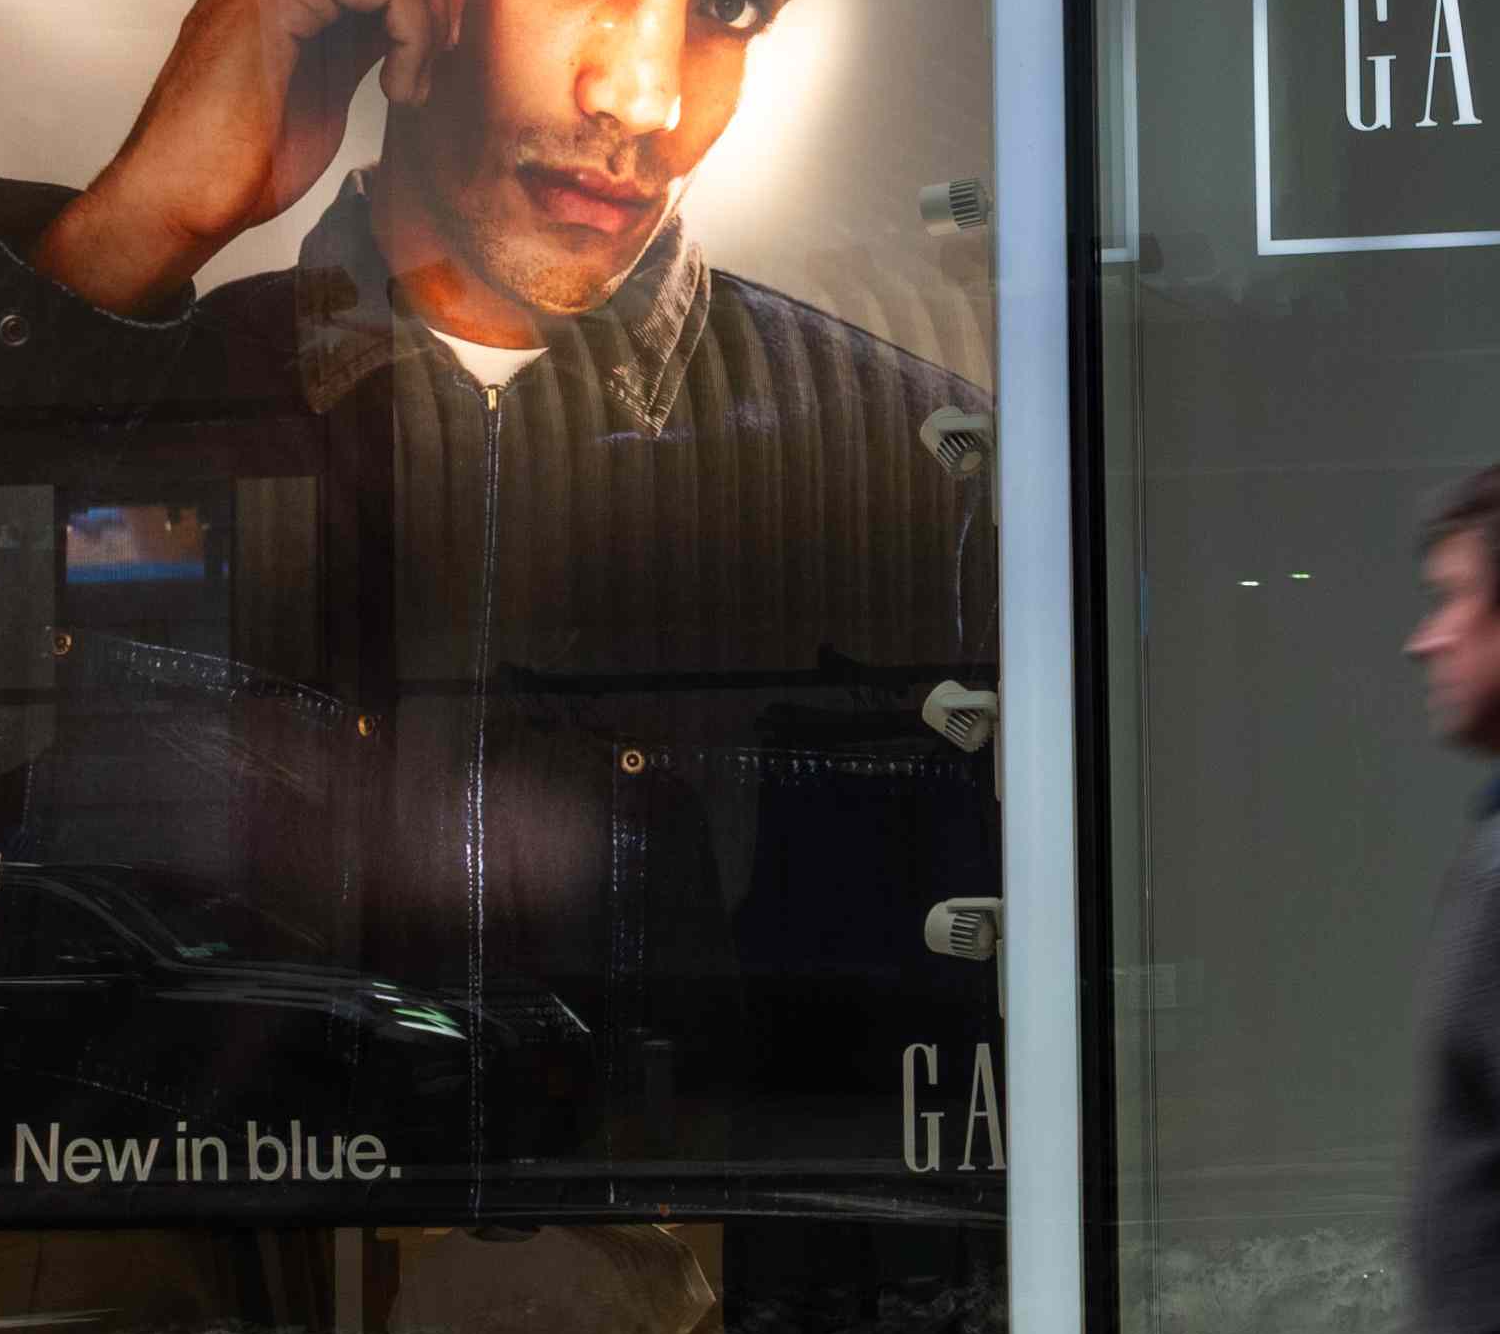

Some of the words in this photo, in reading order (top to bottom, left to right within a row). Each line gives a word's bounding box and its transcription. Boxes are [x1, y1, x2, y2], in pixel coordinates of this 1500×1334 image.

[14, 1122, 160, 1184] New
[176, 1121, 228, 1181] in
[247, 1119, 401, 1181] blue.
